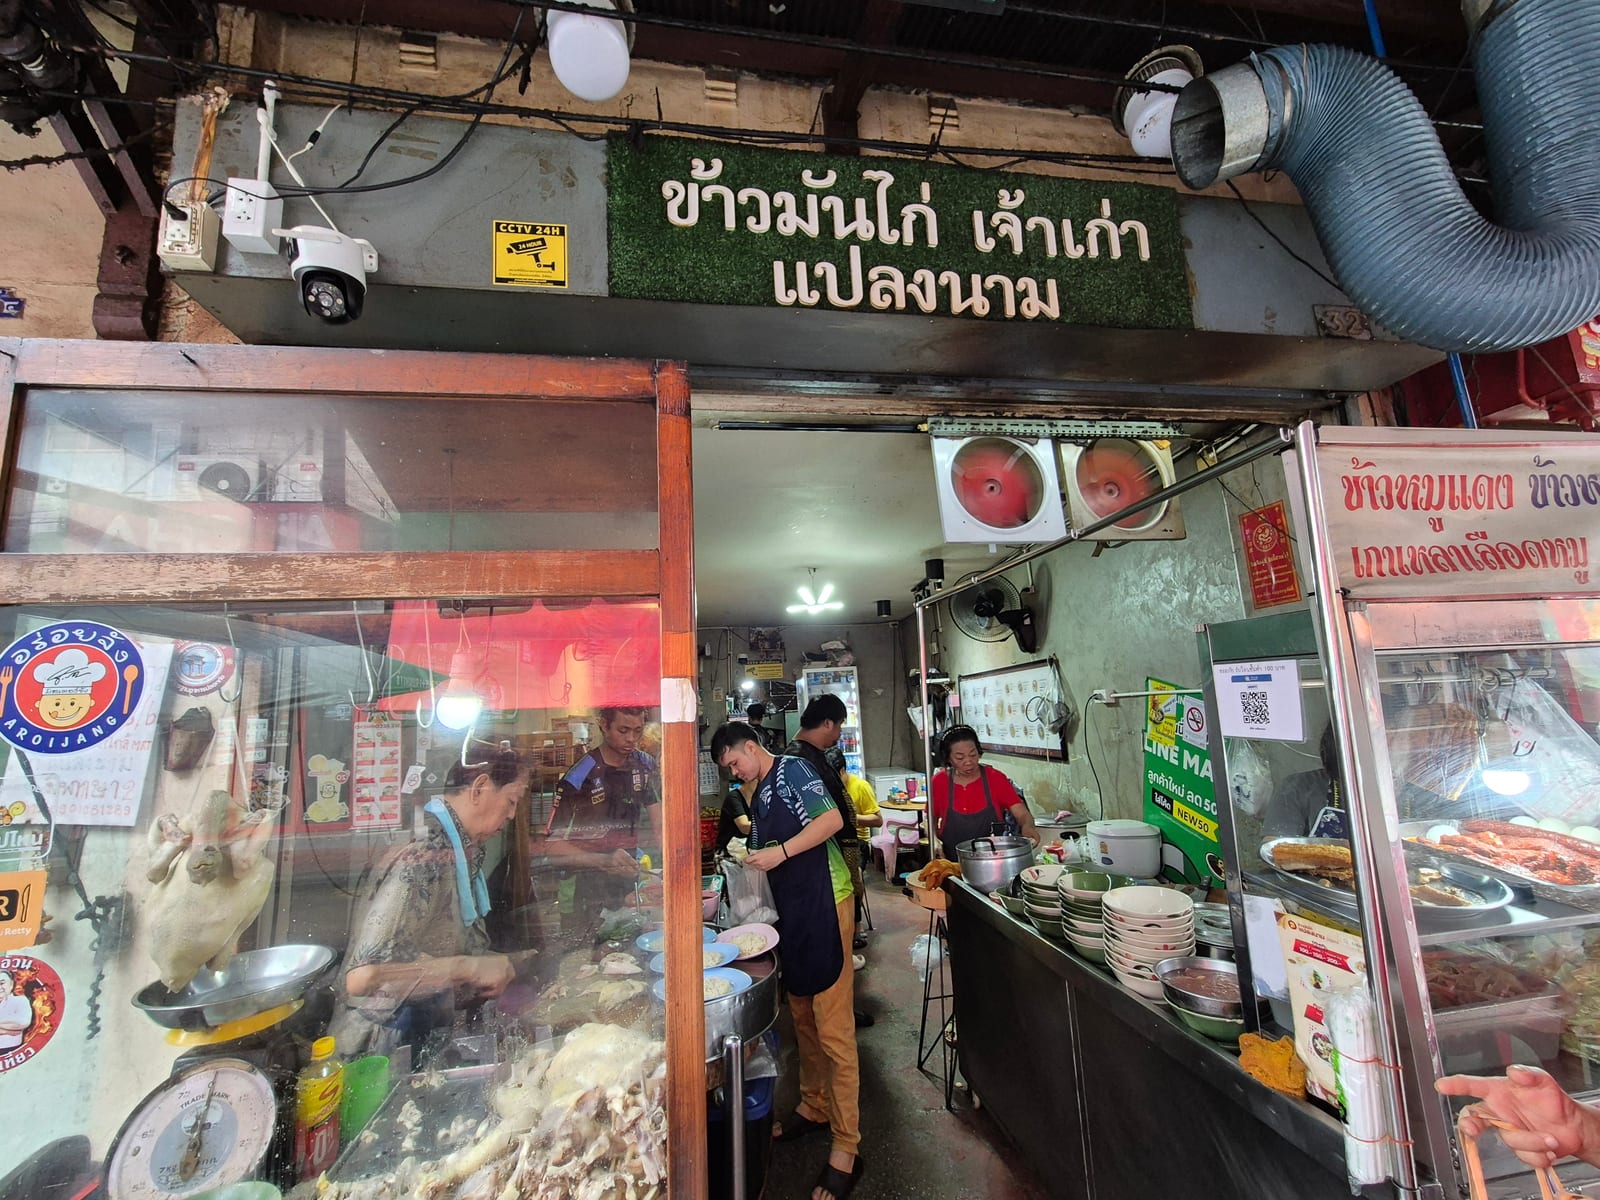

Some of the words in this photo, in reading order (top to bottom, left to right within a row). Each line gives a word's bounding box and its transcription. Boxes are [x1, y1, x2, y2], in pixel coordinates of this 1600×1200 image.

[661, 157, 938, 248] ข้าวมันไก่
[972, 187, 1151, 262] เจ้าเก่า
[499, 223, 532, 234] CCTV
[535, 226, 560, 236] 24H
[772, 244, 1060, 320] แปลงนาม
[1341, 456, 1514, 532] ข้าวหมูแดง
[1352, 530, 1589, 584] เกาเหลาเลือดหมู
[12, 627, 129, 665] อร่อยจัง
[4, 715, 118, 749] AROIJANG
[1143, 738, 1179, 766] LINE
[1147, 769, 1185, 798] ลูกค้าใหม่
[1186, 790, 1202, 808] ลด
[1177, 807, 1209, 833] NEW50
